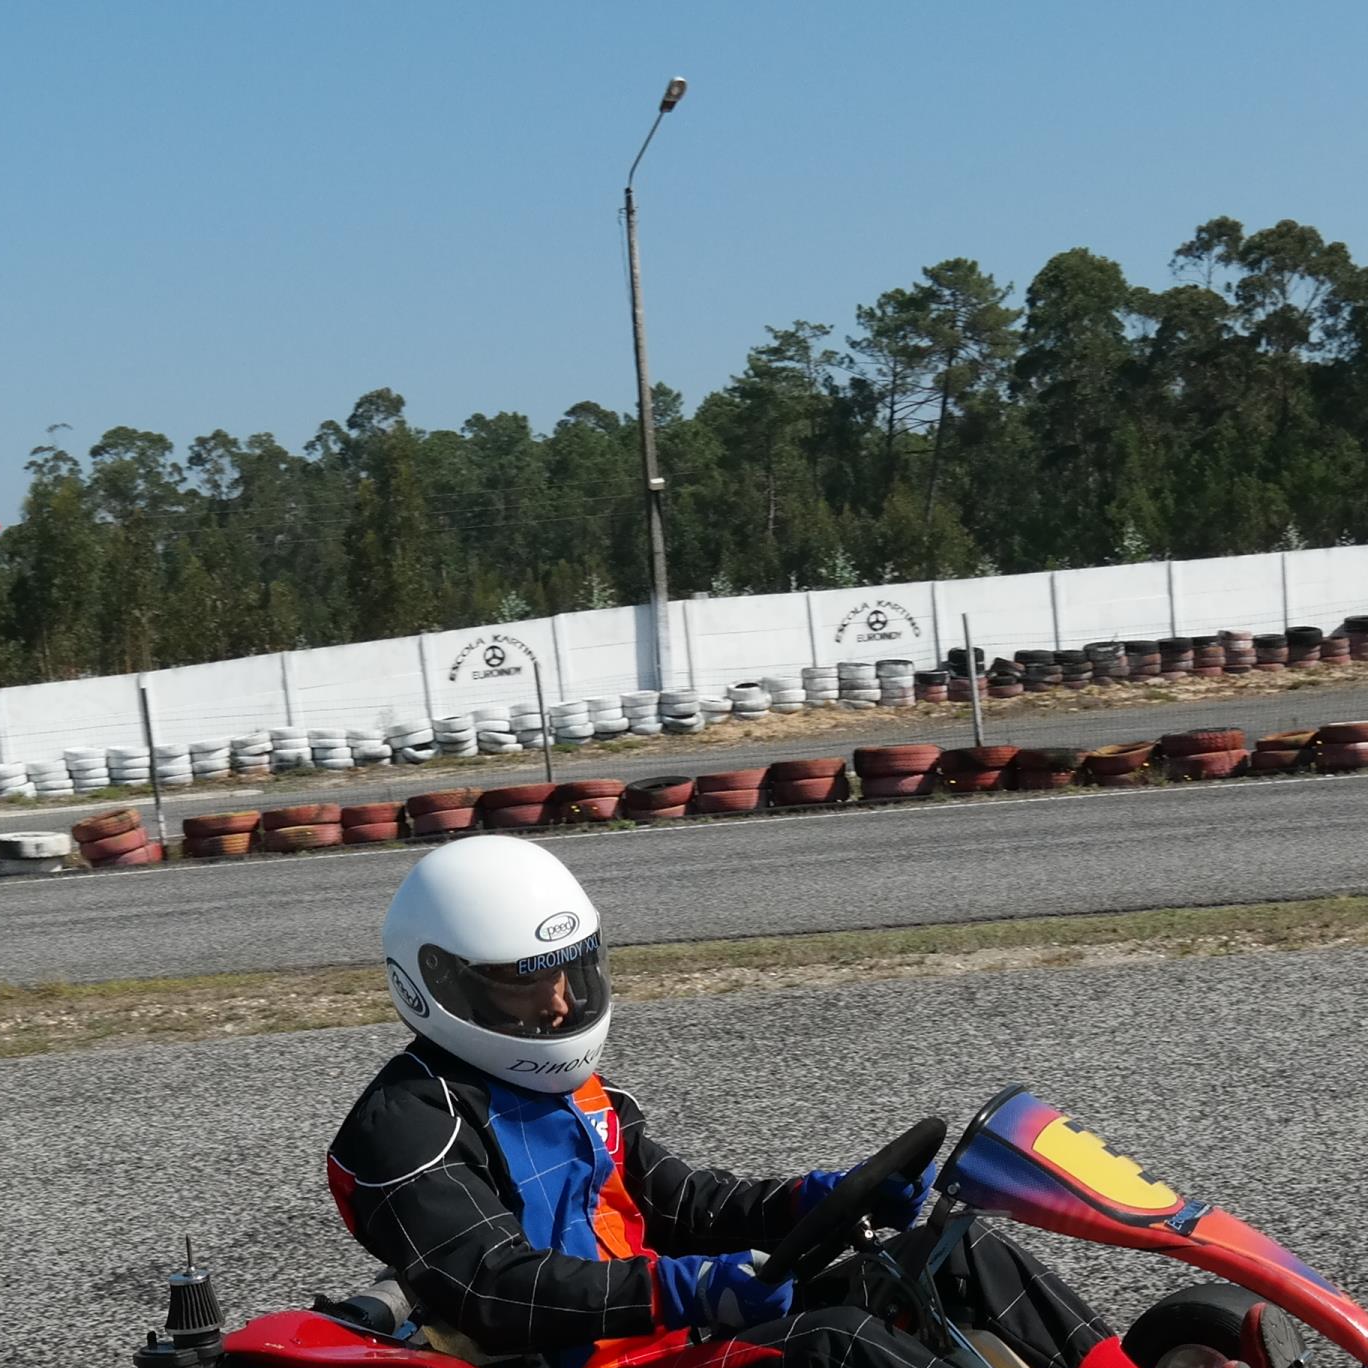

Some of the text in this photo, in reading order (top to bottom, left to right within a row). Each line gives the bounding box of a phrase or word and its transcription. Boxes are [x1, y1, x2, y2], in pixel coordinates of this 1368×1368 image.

[835, 600, 921, 644] ESCOLA KARTING
[449, 634, 540, 681] ESCOLA KARTIN
[518, 941, 583, 975] EUROINDY
